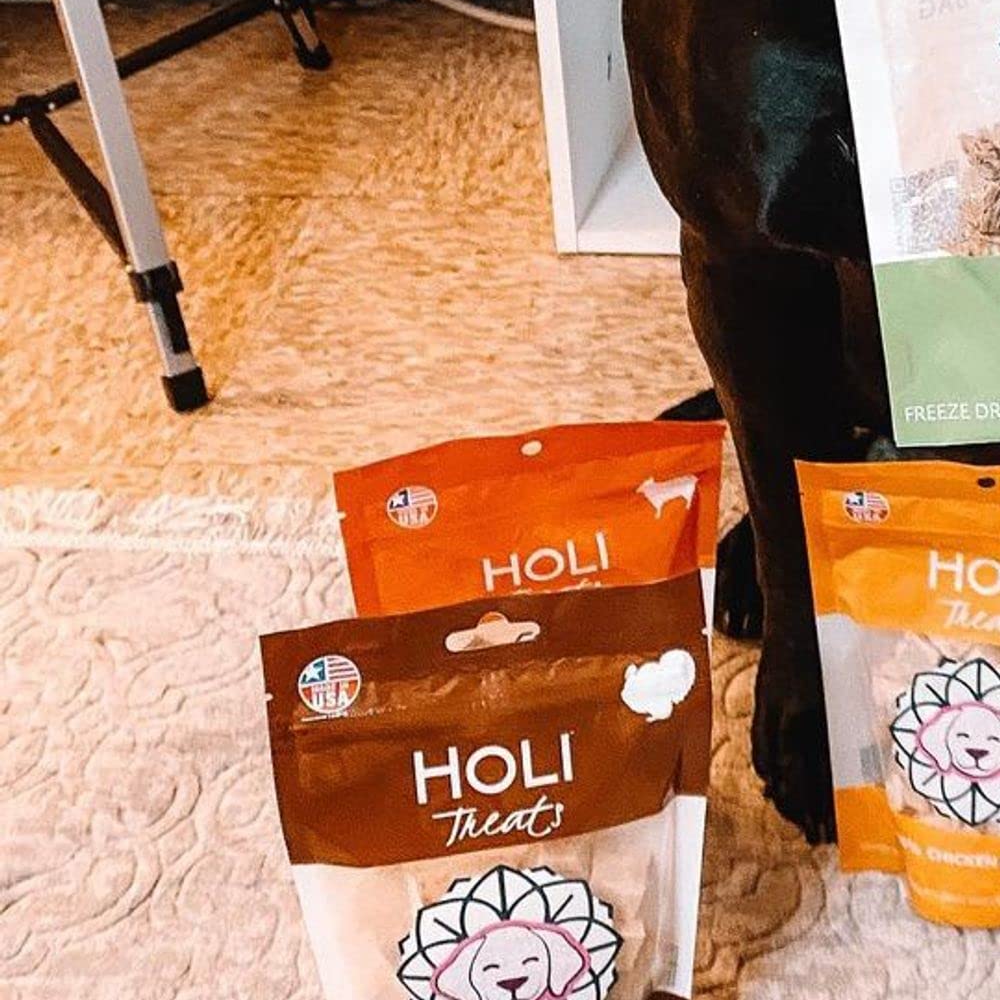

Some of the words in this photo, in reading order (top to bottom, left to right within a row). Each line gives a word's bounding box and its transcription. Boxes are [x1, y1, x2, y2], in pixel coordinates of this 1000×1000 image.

[905, 402, 971, 422] FREEZE
[482, 531, 609, 593] HOLI
[311, 688, 350, 709] USA
[413, 732, 574, 805] HOLI
[432, 795, 564, 847] Treats
